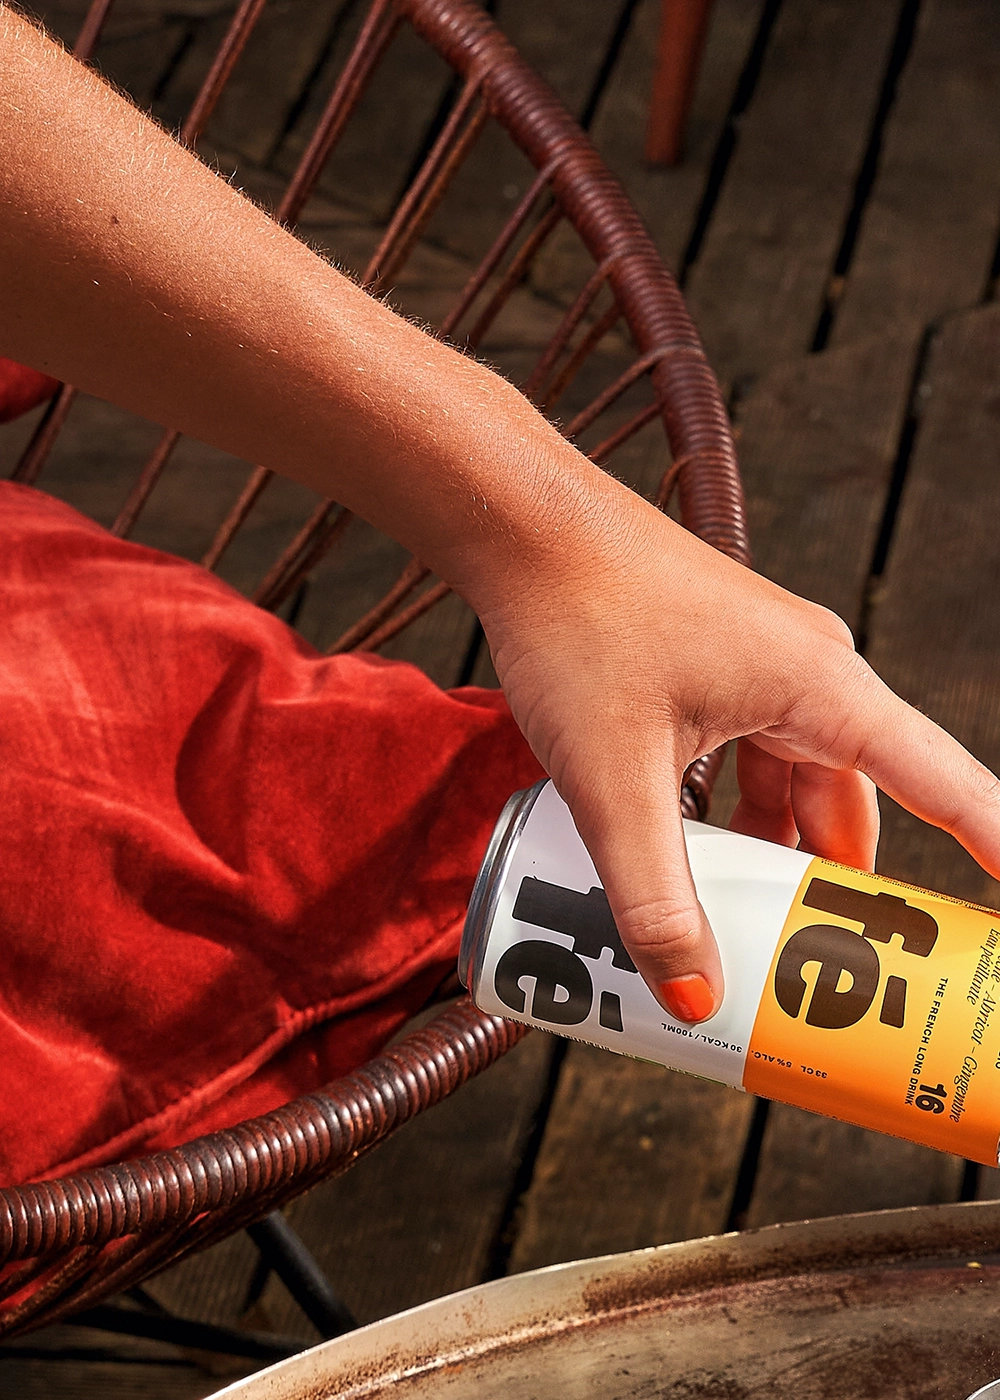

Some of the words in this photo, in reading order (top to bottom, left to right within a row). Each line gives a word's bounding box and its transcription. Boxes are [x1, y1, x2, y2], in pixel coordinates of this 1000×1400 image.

[935, 978, 948, 997] THE
[966, 945, 994, 1005] pétillante
[921, 1000, 940, 1044] FRENCH
[971, 990, 996, 1045] Abricot
[912, 1047, 926, 1075] LONG
[904, 1077, 918, 1106] DRINK
[915, 1084, 947, 1114] 16
[949, 1056, 978, 1123] Gingembre
